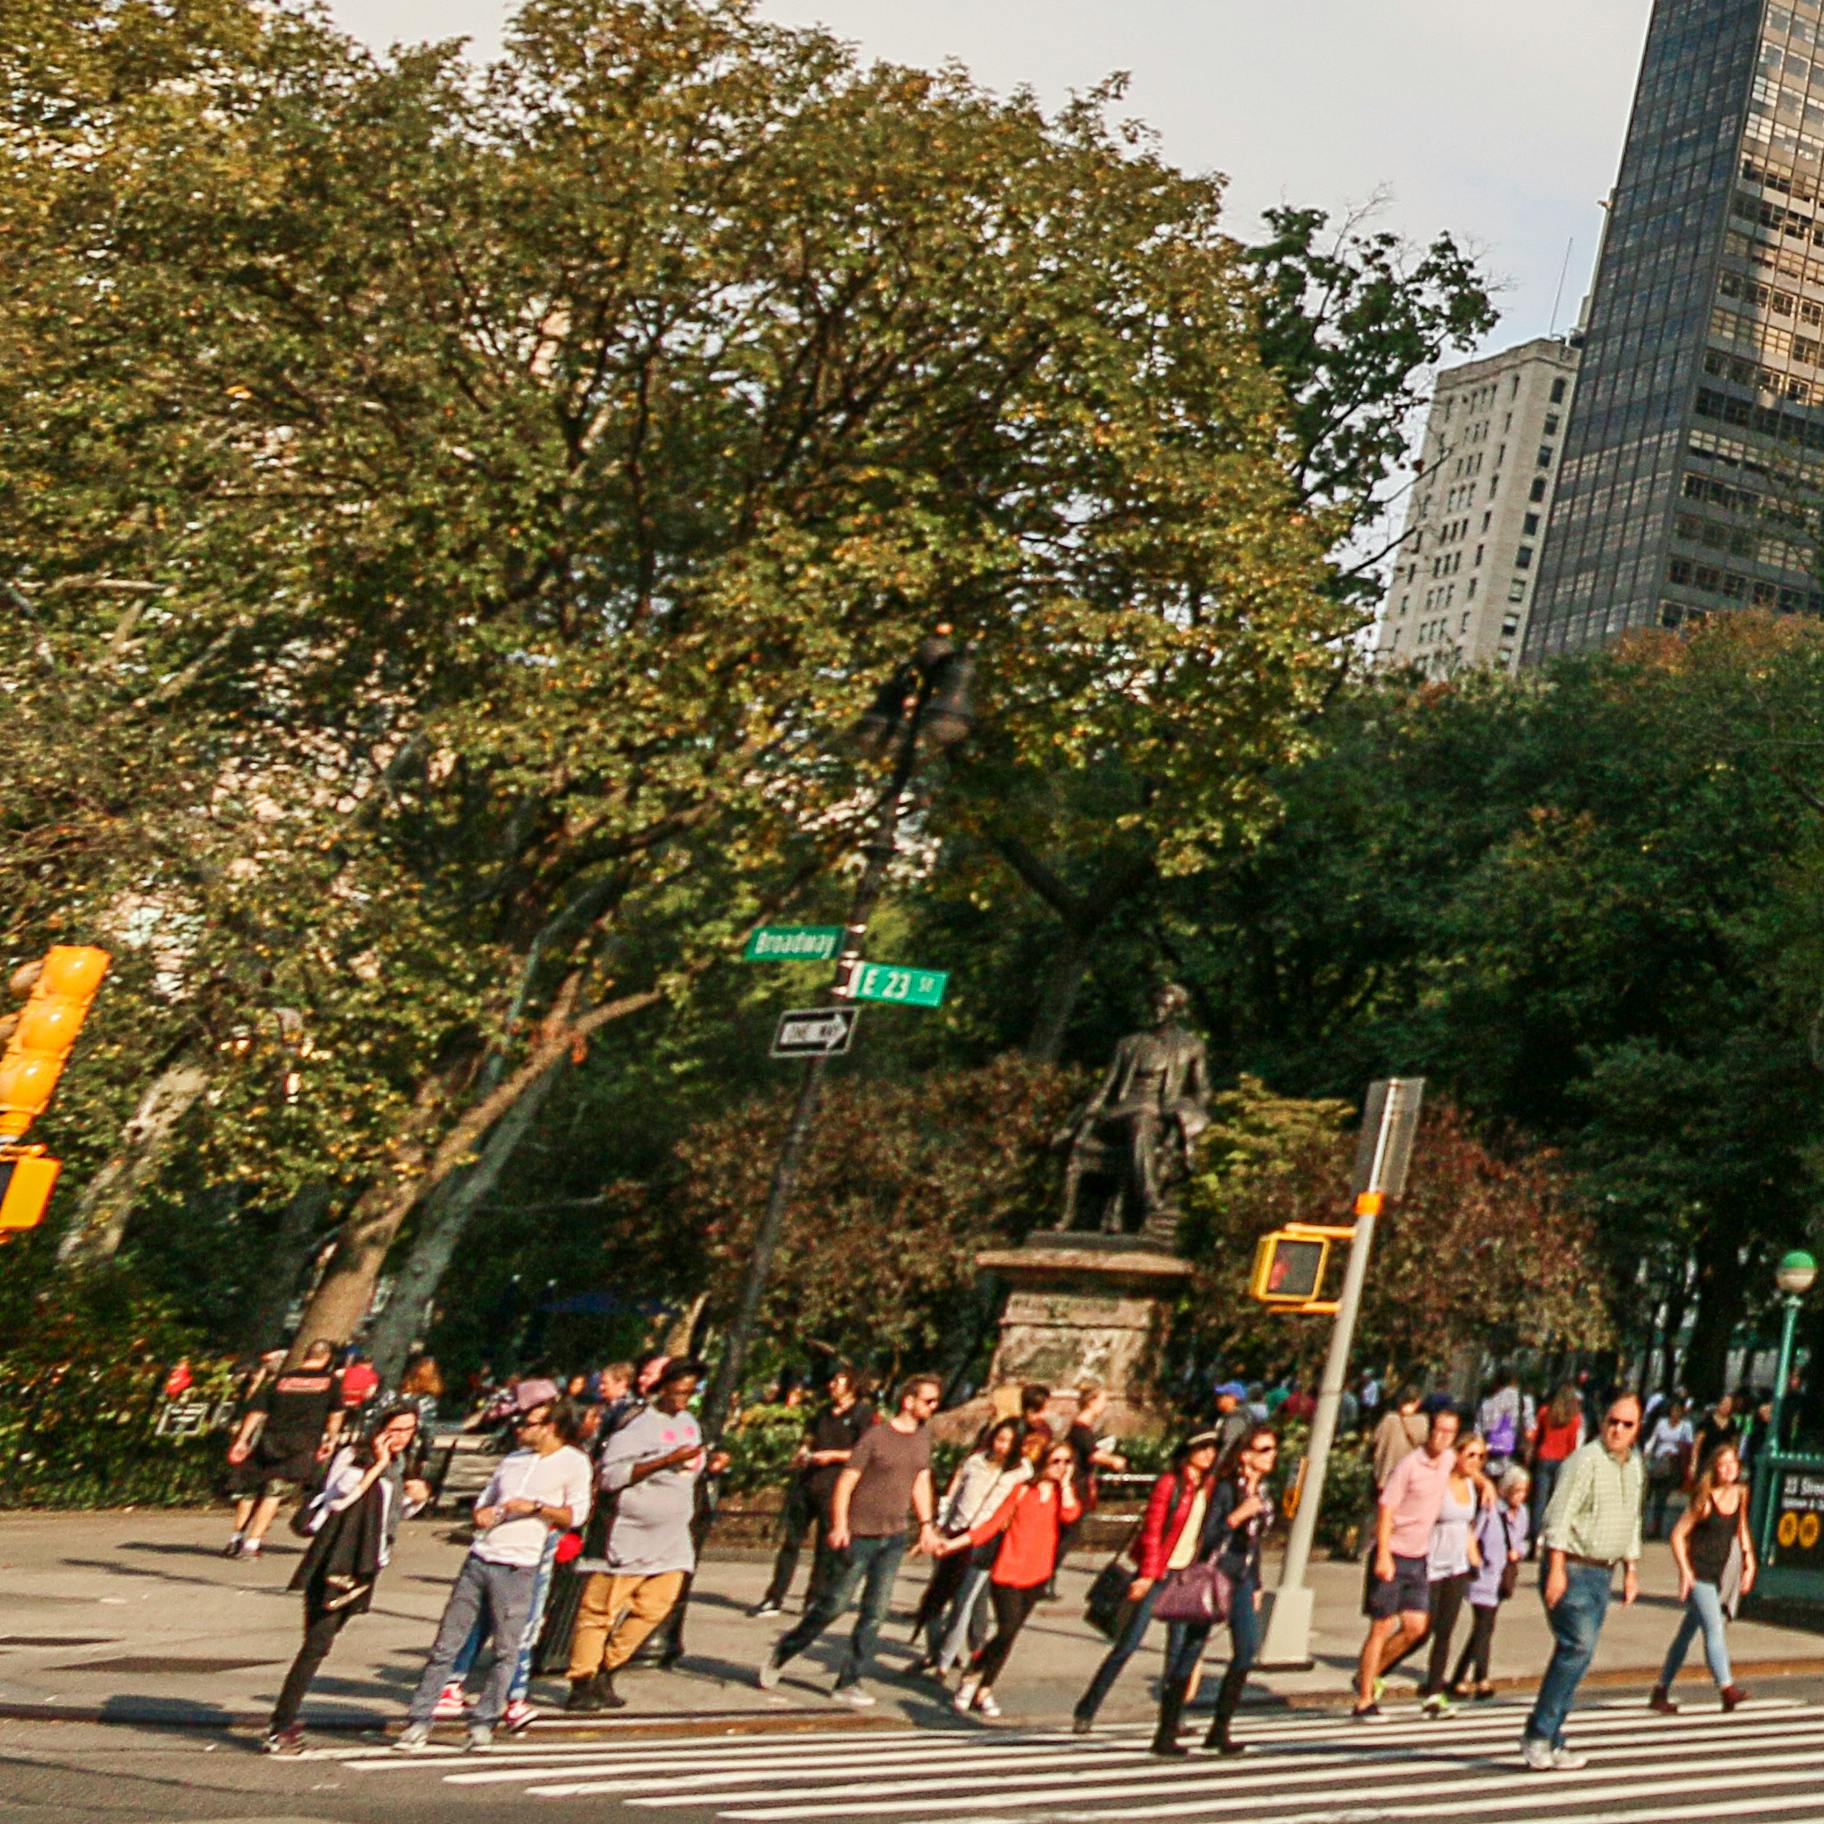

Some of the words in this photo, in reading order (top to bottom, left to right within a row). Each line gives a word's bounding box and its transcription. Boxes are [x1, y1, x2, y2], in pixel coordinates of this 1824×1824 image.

[754, 930, 837, 960] Broadway
[861, 968, 880, 996] E
[882, 971, 913, 1001] 23
